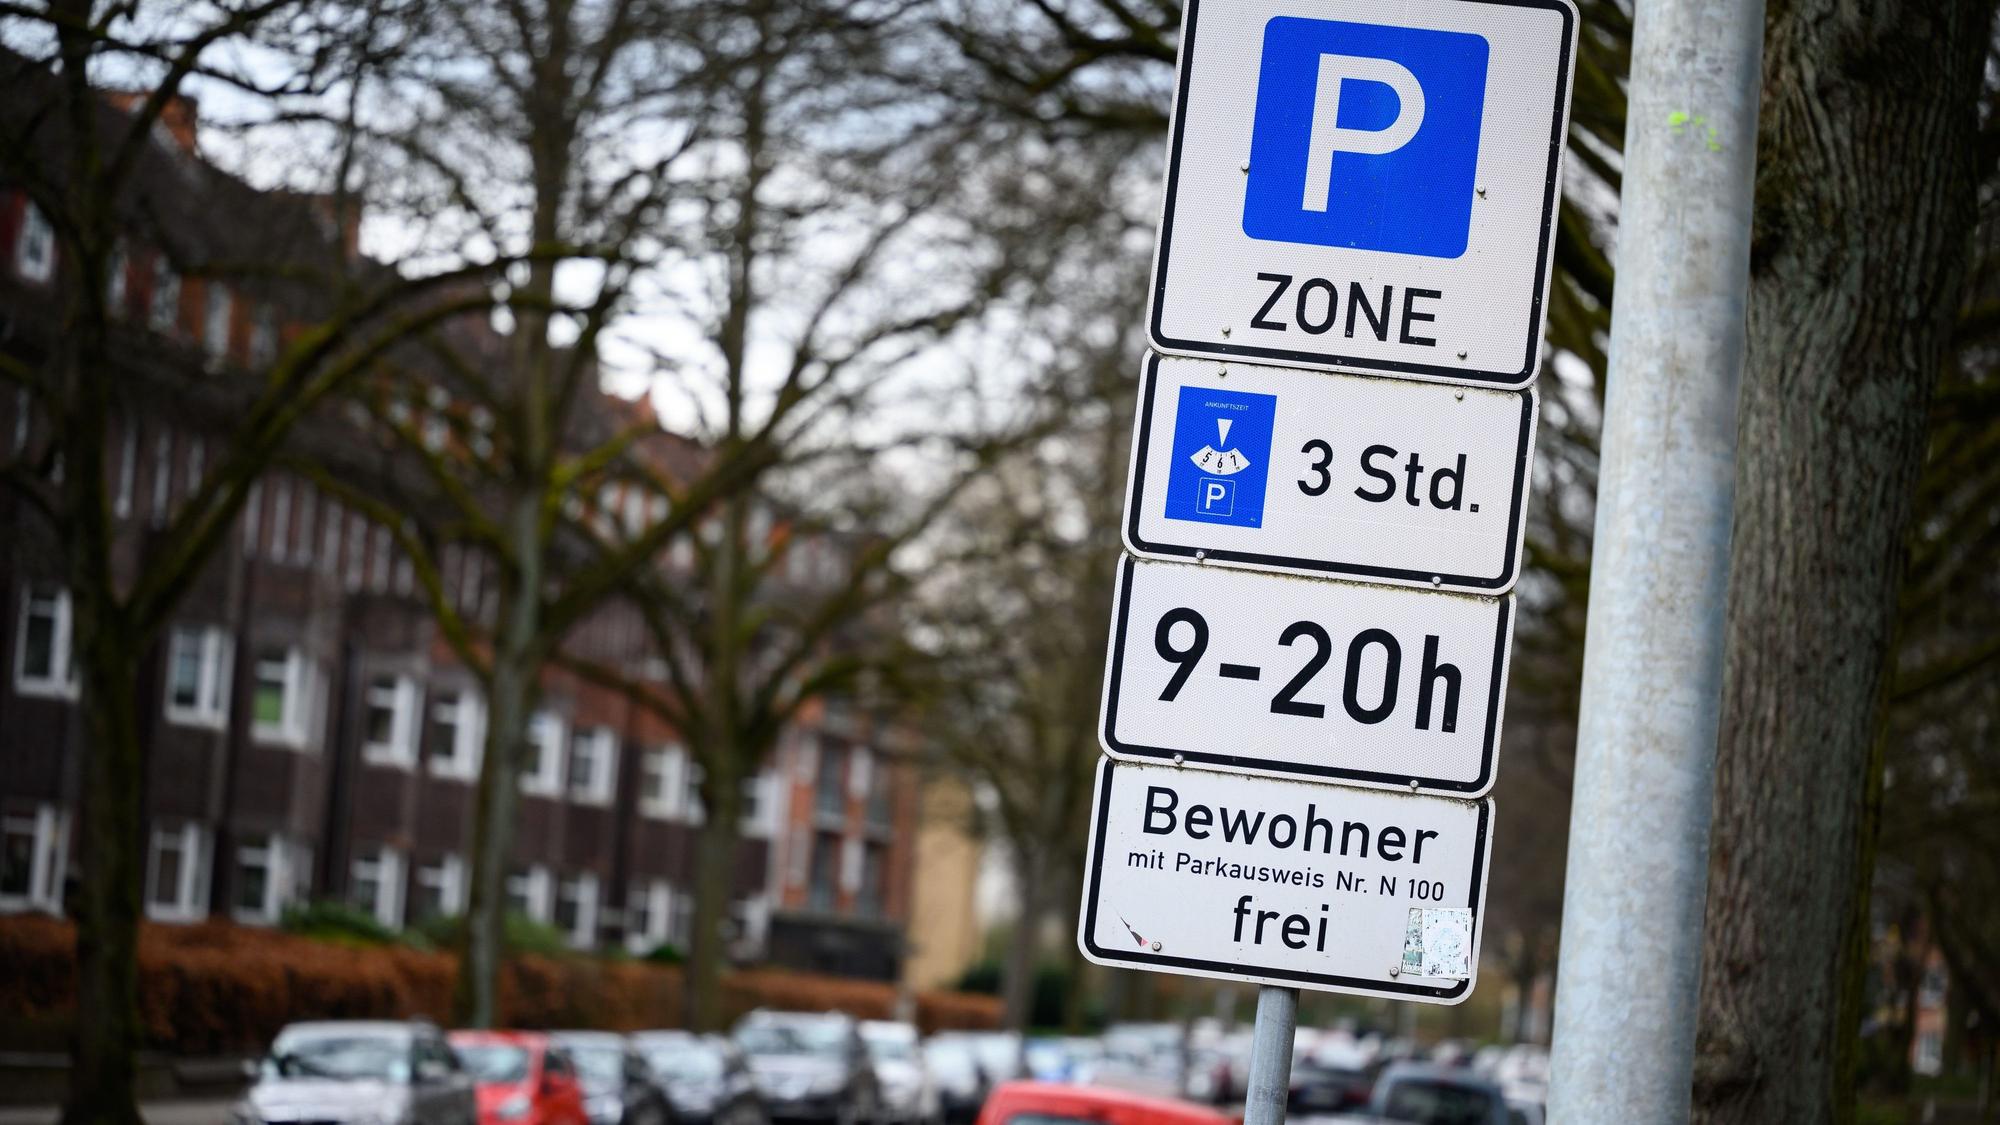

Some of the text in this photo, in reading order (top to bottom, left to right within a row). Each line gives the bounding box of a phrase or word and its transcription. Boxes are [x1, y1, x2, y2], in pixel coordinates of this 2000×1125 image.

[1301, 52, 1426, 213] P
[1250, 272, 1442, 347] ZONE
[1204, 401, 1249, 411] ANKUNFTSZEIT
[1202, 452, 1212, 463] 5
[1217, 457, 1223, 469] 6
[1230, 454, 1237, 467] 7
[1297, 438, 1480, 513] 3 Std.
[1205, 483, 1226, 510] P
[1154, 607, 1462, 734] 9-20h
[1142, 785, 1439, 865] Bewohner
[1127, 851, 1445, 902] mit Parkausweis Nr. N 100
[1233, 895, 1330, 953] frei
